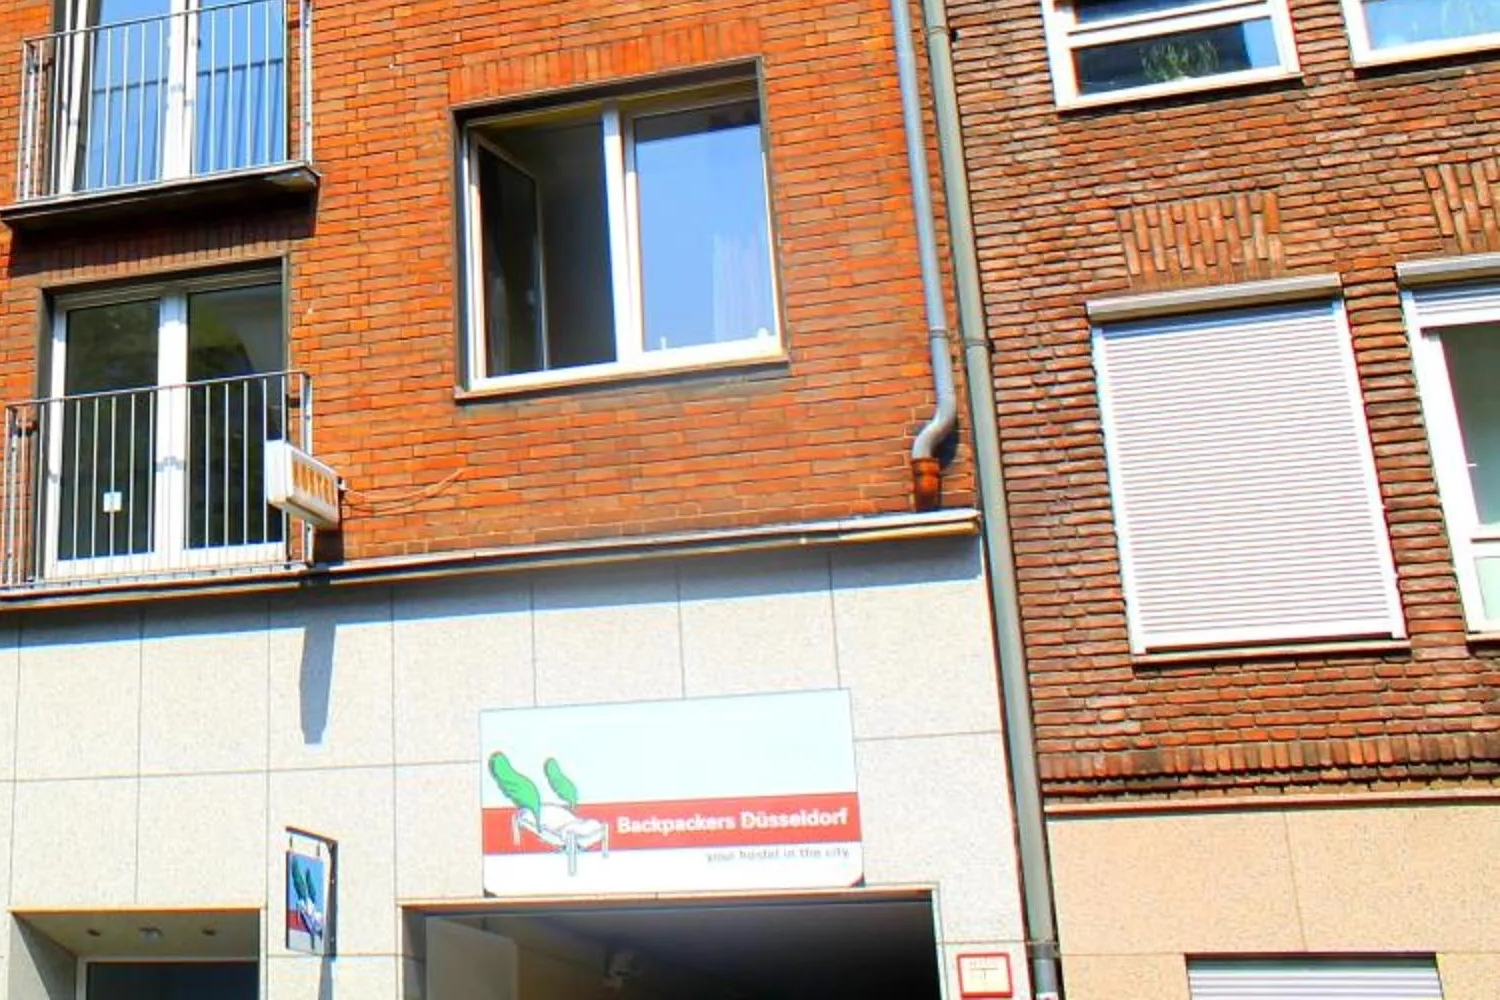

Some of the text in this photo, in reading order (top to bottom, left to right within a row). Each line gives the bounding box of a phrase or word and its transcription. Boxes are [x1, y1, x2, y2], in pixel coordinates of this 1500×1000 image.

[617, 807, 848, 836] Backpackers Düsseldorf
[784, 847, 796, 858] in
[799, 847, 822, 858] the
